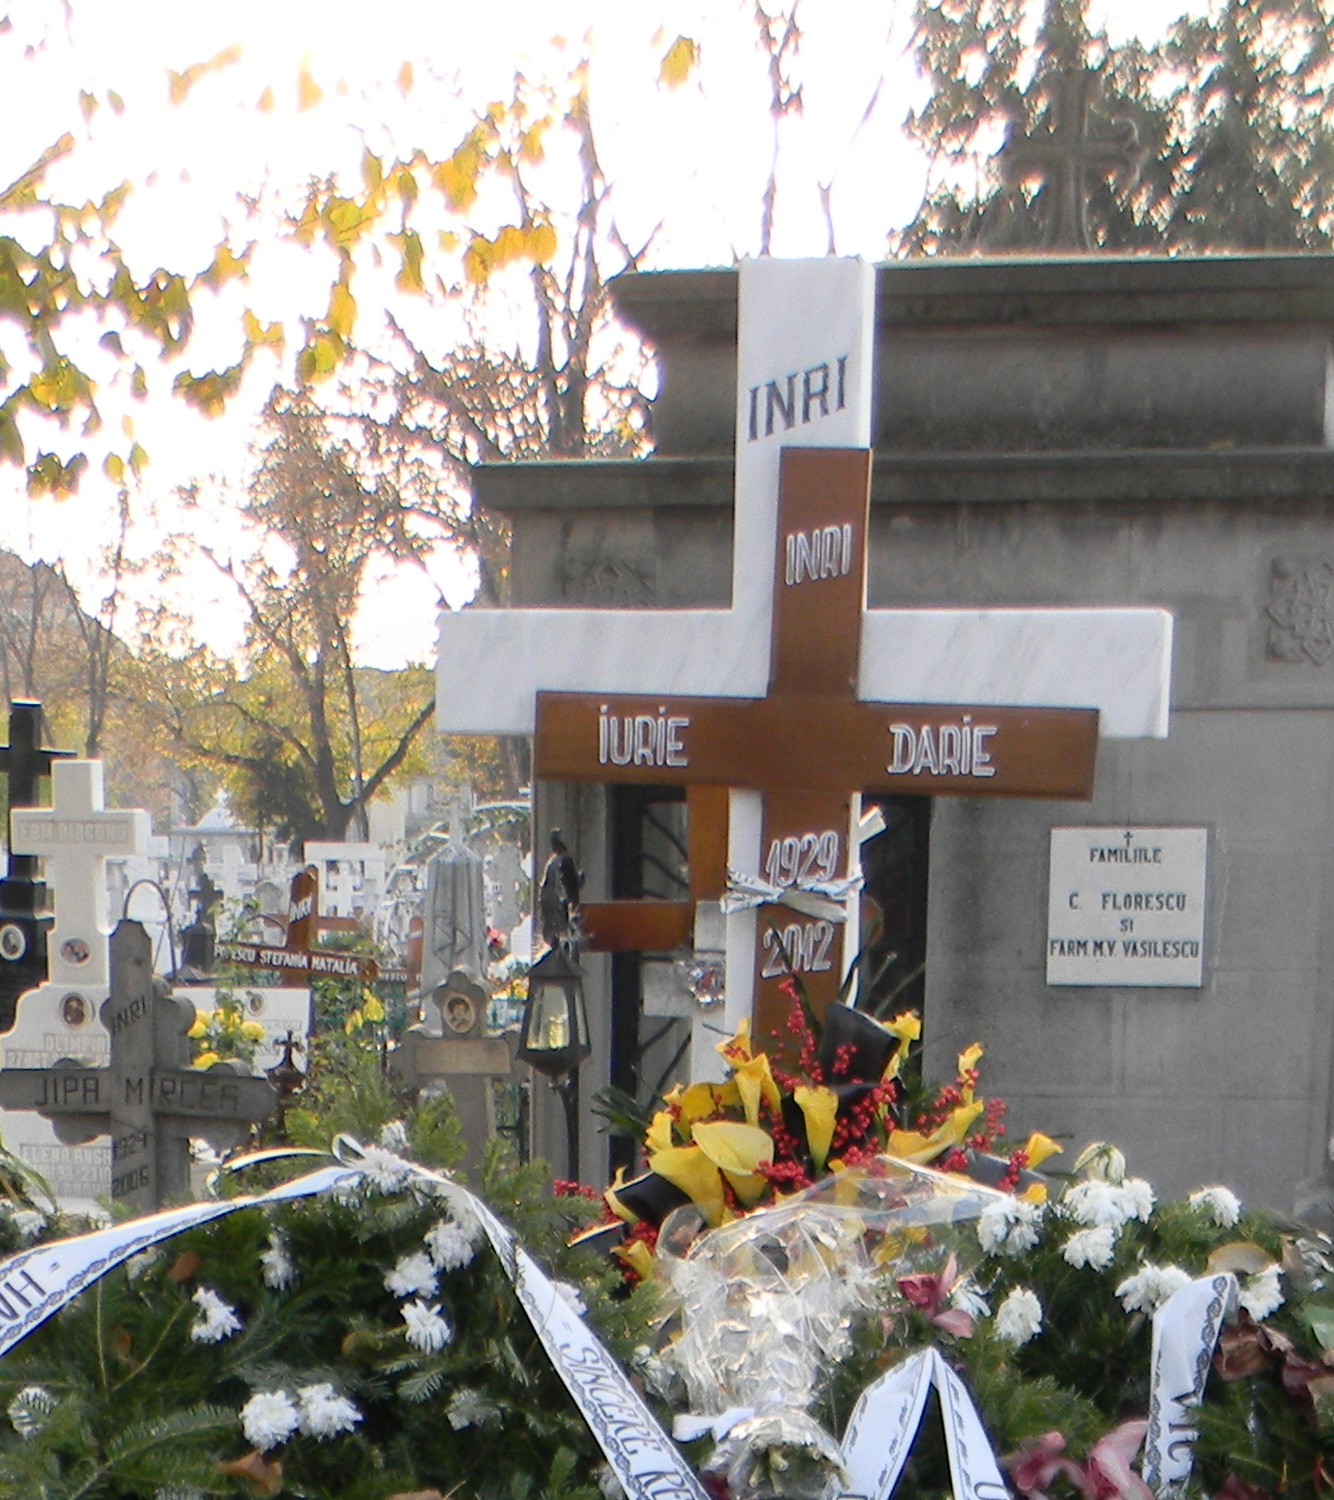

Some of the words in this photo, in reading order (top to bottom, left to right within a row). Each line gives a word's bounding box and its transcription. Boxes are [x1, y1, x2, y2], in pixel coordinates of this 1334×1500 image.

[747, 355, 850, 443] INRI
[785, 524, 852, 586] INRI
[766, 830, 839, 887] 1929
[1089, 847, 1162, 864] FAMILIILE
[1101, 893, 1187, 911] FLORESCU
[762, 919, 835, 979] 2012
[1122, 940, 1200, 959] VASILESCU
[35, 1076, 100, 1108] JIPA
[125, 1077, 239, 1113] MIRCEA
[560, 1338, 663, 1457] SINCERE
